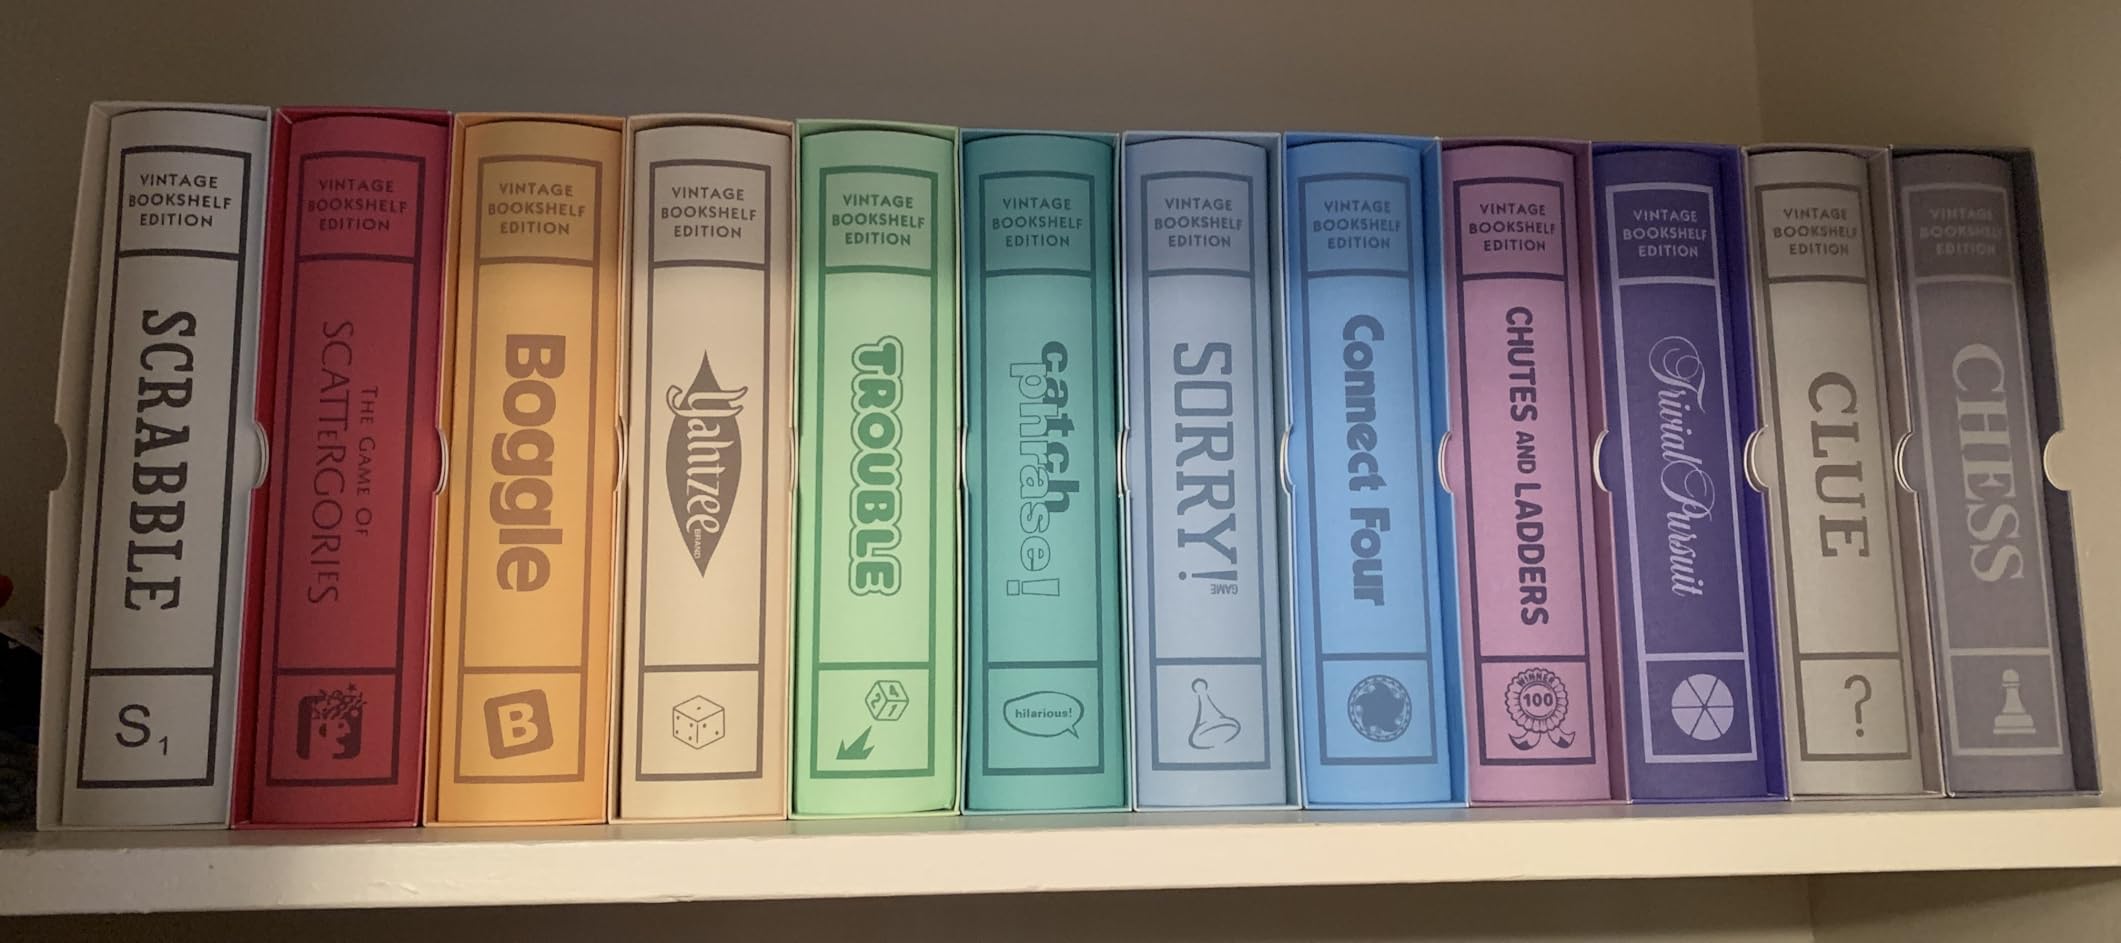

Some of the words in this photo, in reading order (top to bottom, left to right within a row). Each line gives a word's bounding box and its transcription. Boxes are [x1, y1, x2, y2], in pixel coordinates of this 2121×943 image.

[140, 174, 218, 189] VINTAGE
[319, 178, 394, 193] VINTAGE
[499, 182, 574, 197] VINTAGE
[671, 186, 745, 201] VINTAGE
[129, 193, 232, 210] BOOKSHELF
[307, 198, 409, 214] BOOKSHELF
[843, 193, 914, 209] VINTAGE
[1002, 197, 1072, 211] VINTAGE
[1164, 197, 1233, 212] VINTAGE
[1324, 200, 1391, 214] VINTAGE
[487, 201, 586, 218] BOOKSHELF
[660, 205, 758, 222] BOOKSHELF
[1479, 203, 1546, 216] VINTAGE
[1632, 209, 1698, 223] VINTAGE
[1783, 208, 1848, 221] VINTAGE
[1929, 207, 1993, 221] VINTAGE
[140, 213, 213, 228] EDITION
[319, 217, 390, 231] EDITION
[831, 212, 926, 230] BOOKSHELF
[992, 216, 1084, 231] BOOKSHELF
[1154, 215, 1243, 231] BOOKSHELF
[1313, 217, 1402, 233] BOOKSHELF
[1468, 221, 1556, 235] BOOKSHELF
[500, 221, 570, 236] EDITION
[674, 224, 742, 239] EDITION
[1622, 227, 1708, 242] BOOKSHELF
[1773, 225, 1857, 239] BOOKSHELF
[1919, 225, 2001, 239] BOOKSHELF
[844, 232, 911, 246] EDITION
[1005, 234, 1070, 248] EDITION
[1168, 235, 1231, 248] EDITION
[1327, 236, 1391, 250] EDITION
[1483, 239, 1546, 252] EDITION
[1637, 244, 1699, 258] EDITION
[1789, 243, 1849, 256] EDITION
[1935, 243, 1996, 256] EDITION
[1505, 306, 1538, 423] CHUTES
[359, 385, 379, 424] THE
[1342, 314, 1387, 492] Connect
[1648, 336, 1706, 465] Trivial
[1041, 341, 1080, 513] catch
[665, 384, 749, 533] Yahtzee
[1515, 430, 1536, 474] AND
[124, 309, 197, 611] SCRABBLE
[307, 321, 354, 605] SCATTERGORIES
[354, 436, 376, 497] GAME
[489, 334, 566, 592] Boggle
[849, 335, 904, 596] TROUBLE
[1173, 342, 1238, 581] SORRY!
[1808, 371, 1870, 557] CLUE
[1952, 343, 2024, 582] CHESS
[1006, 362, 1061, 597] phrase!
[1660, 459, 1715, 597] Pursuit
[1350, 507, 1391, 606] Four
[1514, 482, 1550, 626] LADDERS
[1210, 583, 1239, 595] GAME
[1516, 672, 1555, 687] WINNER
[1523, 693, 1553, 707] 100
[1015, 707, 1073, 720] hilarious!
[497, 702, 539, 748] B
